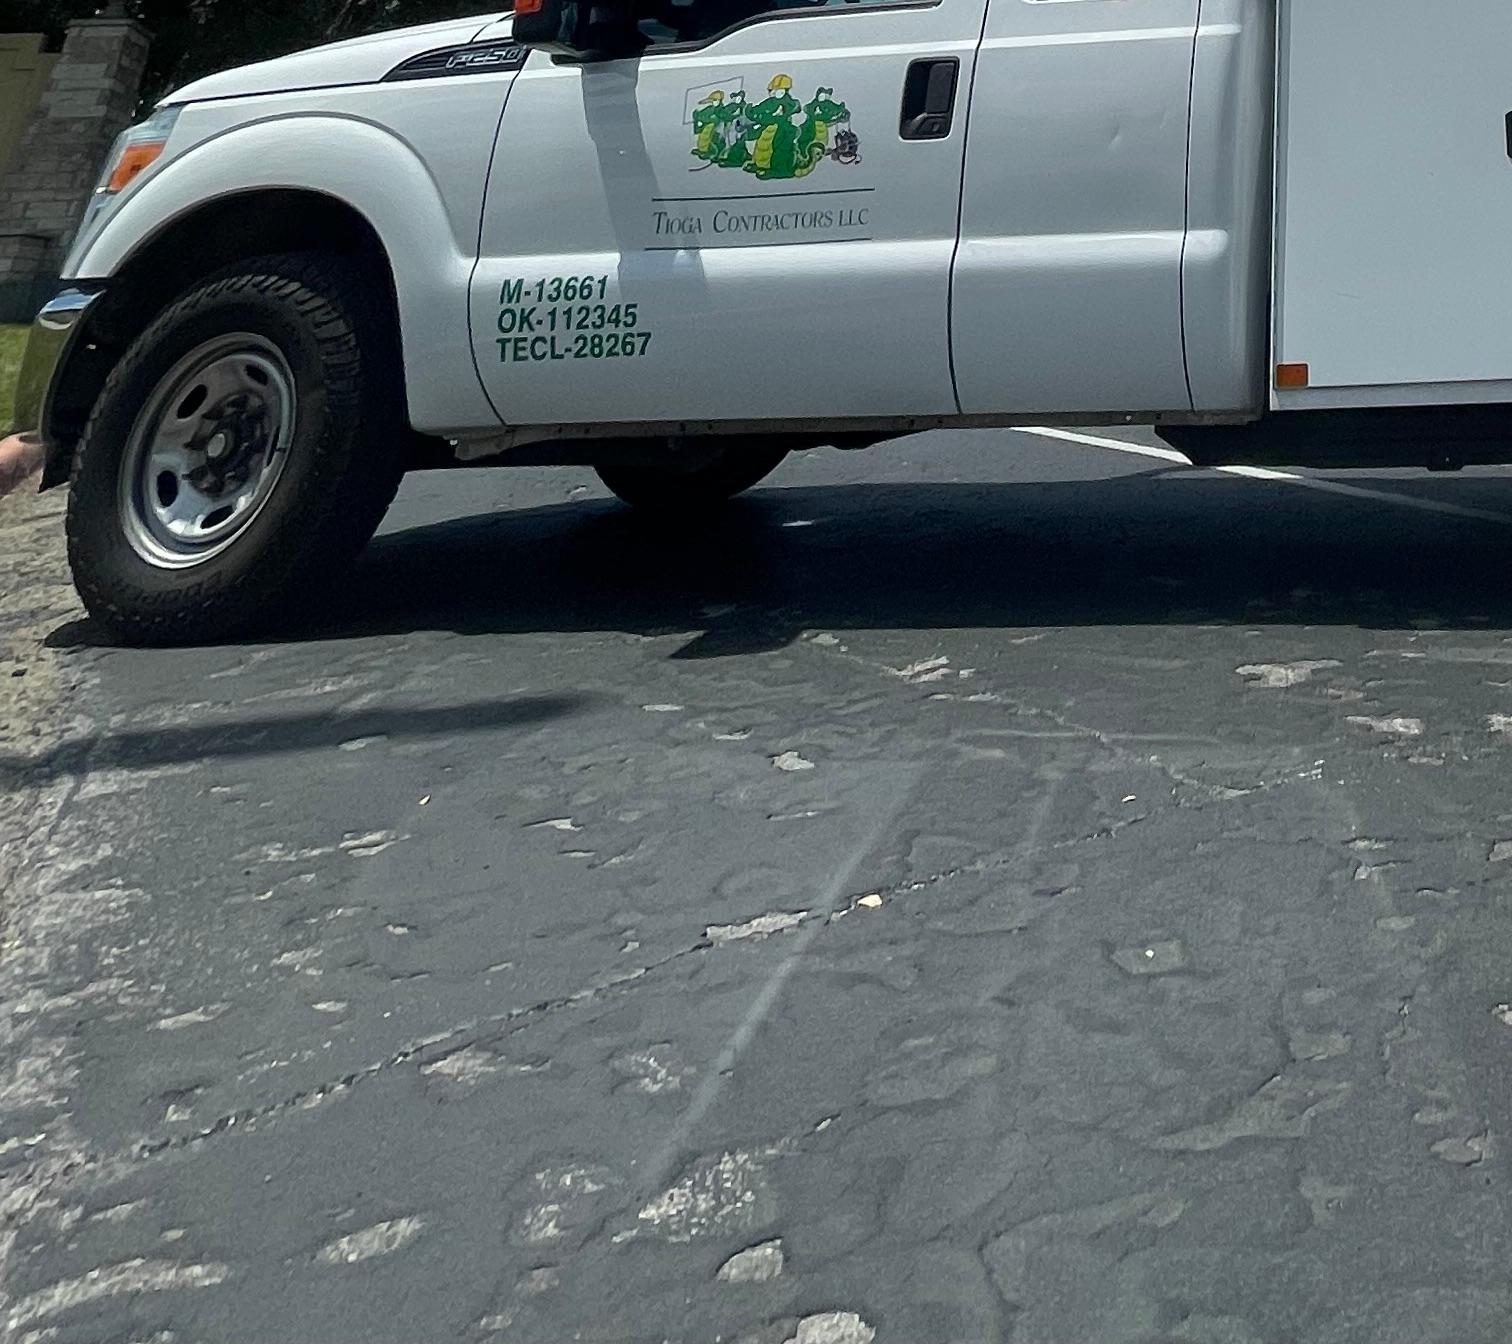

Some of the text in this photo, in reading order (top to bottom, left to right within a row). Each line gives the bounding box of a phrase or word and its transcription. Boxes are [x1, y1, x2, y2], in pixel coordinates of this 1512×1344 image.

[652, 208, 870, 235] TIOGA CONTRACTORS LLC
[500, 274, 609, 305] M-13661
[497, 303, 638, 334] OK-112345
[495, 331, 652, 363] TECL-28267
